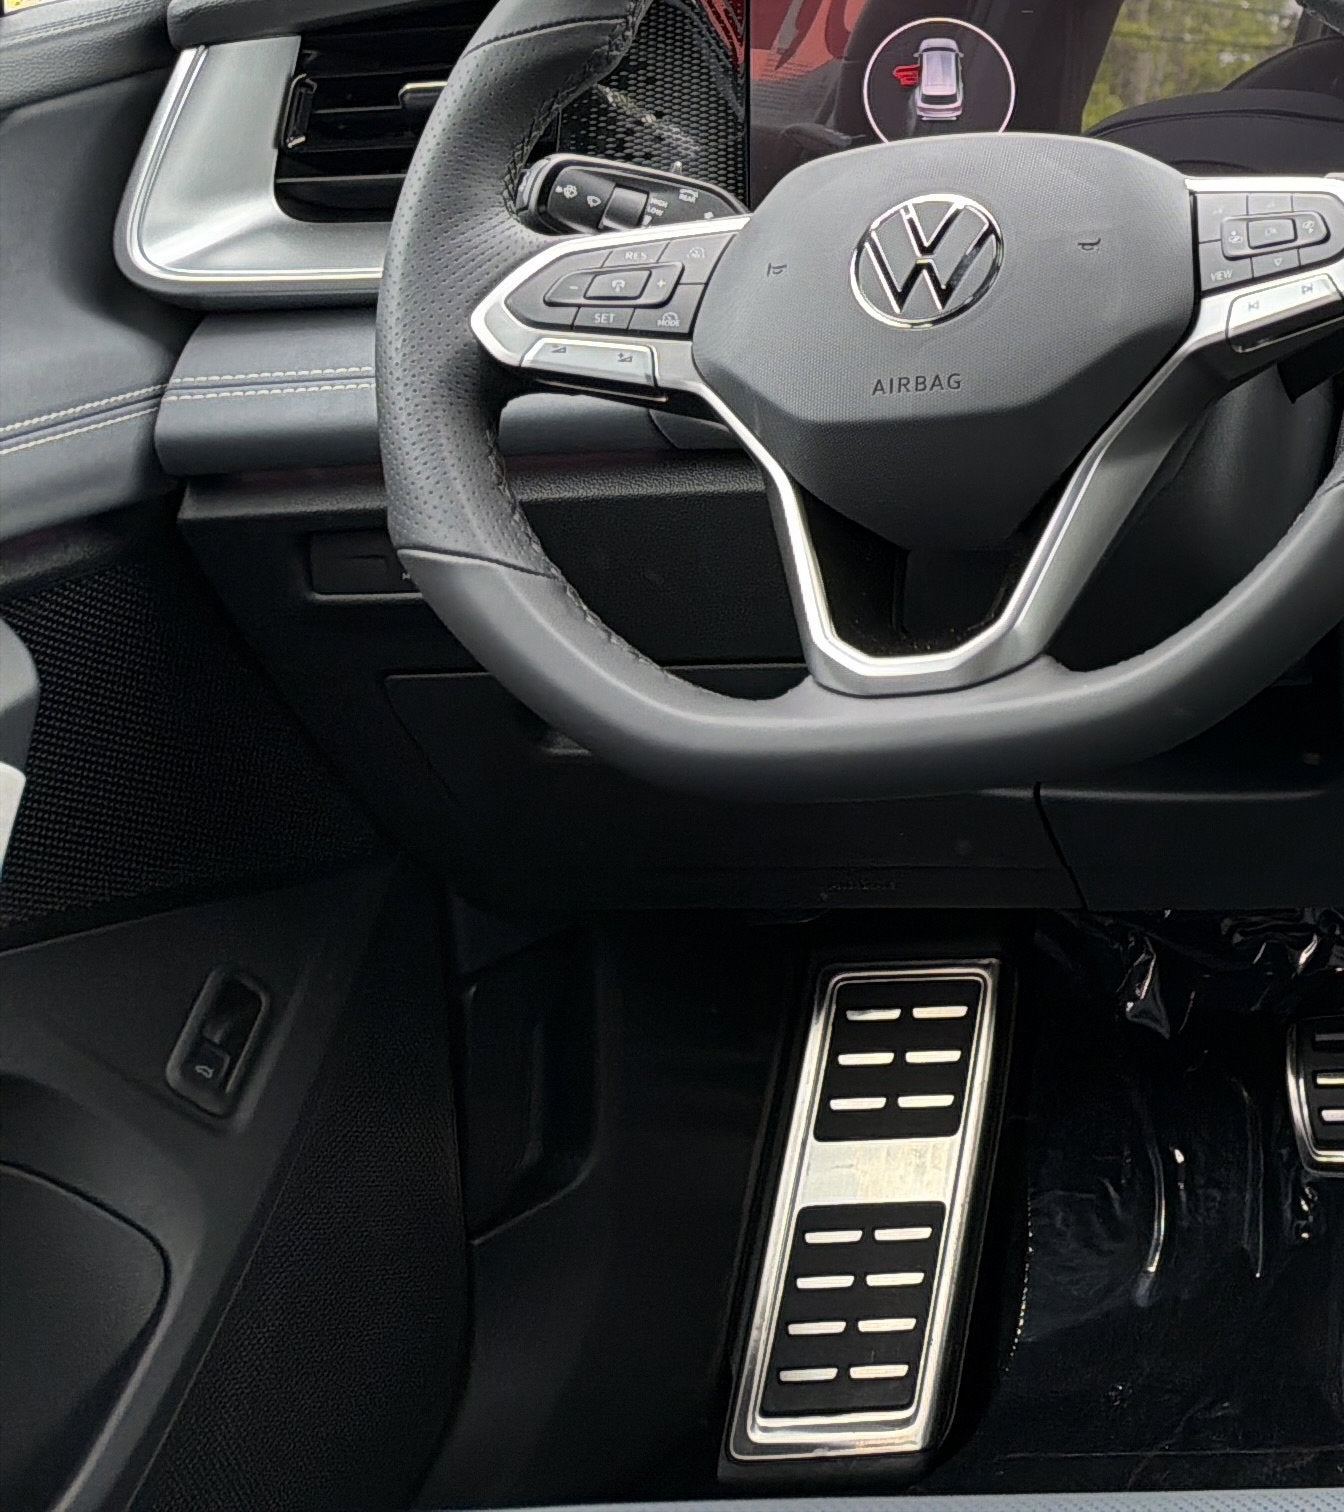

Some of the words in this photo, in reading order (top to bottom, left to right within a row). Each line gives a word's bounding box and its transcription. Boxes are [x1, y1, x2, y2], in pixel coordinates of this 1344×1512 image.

[650, 196, 668, 209] HIGH
[678, 194, 696, 204] REAR
[646, 206, 664, 217] LOW
[624, 251, 647, 260] RES
[1211, 269, 1232, 281] VIEW
[594, 313, 616, 324] SET
[657, 318, 680, 327] MODE
[872, 373, 962, 396] AIRBAG
